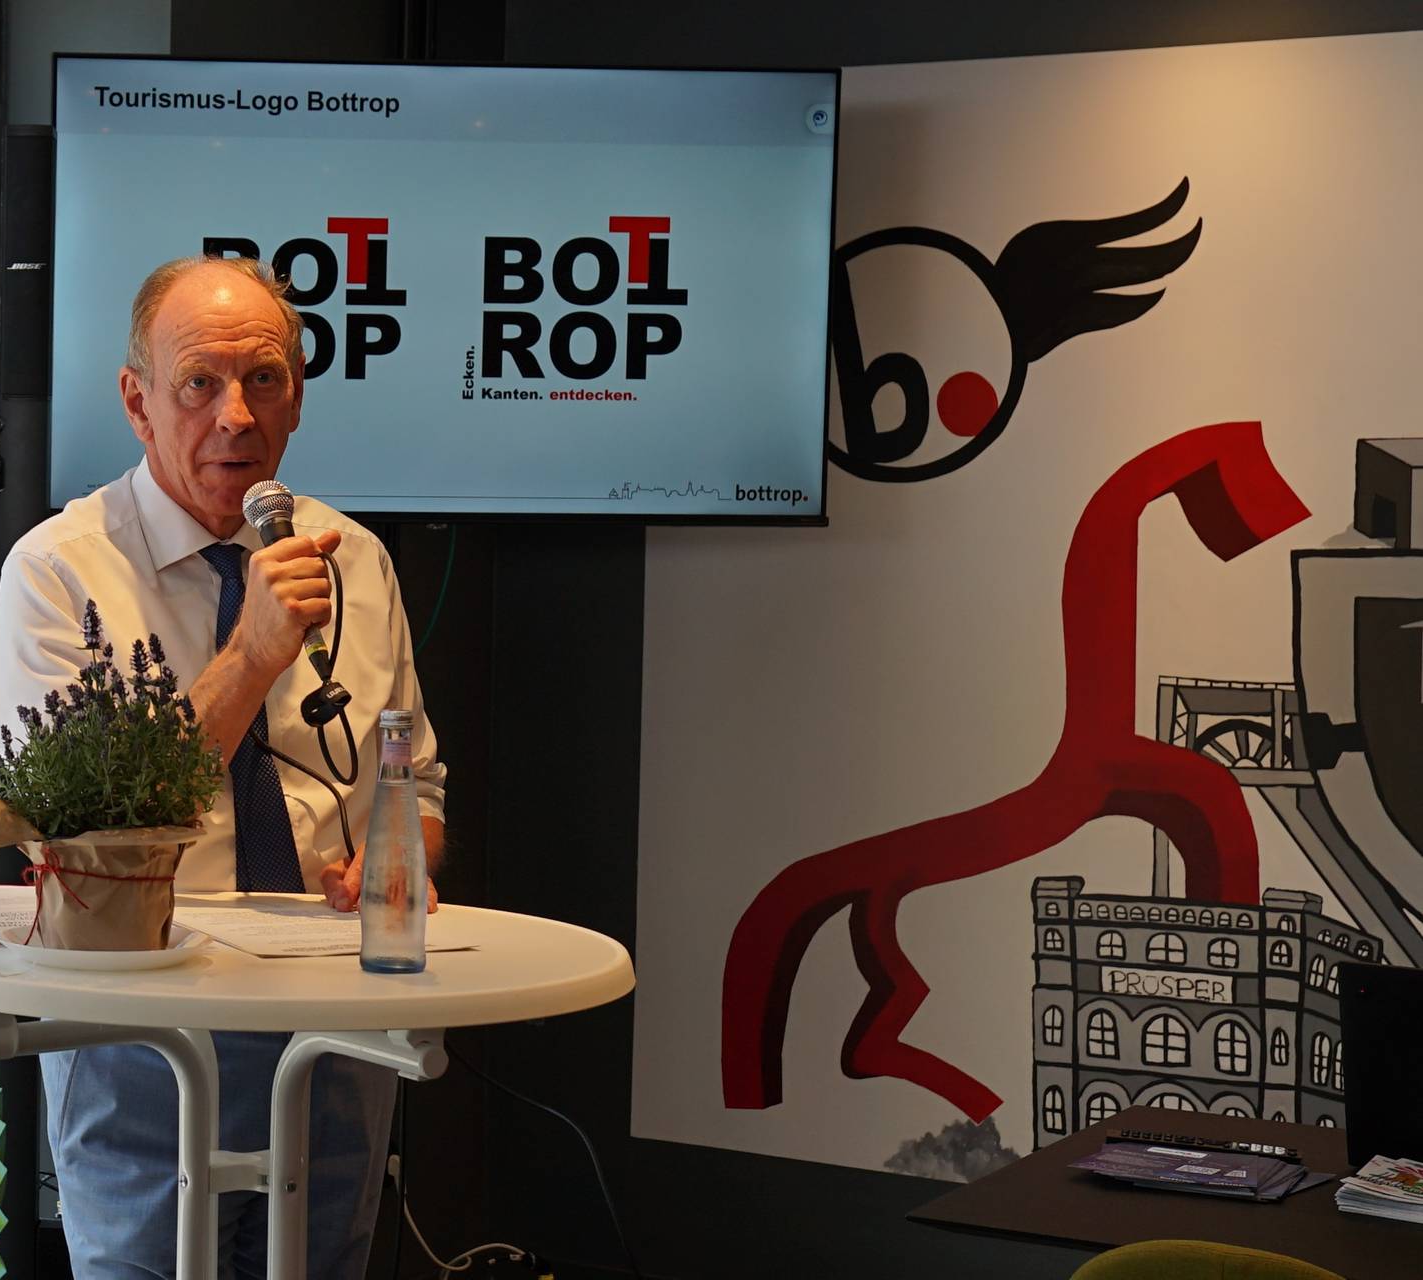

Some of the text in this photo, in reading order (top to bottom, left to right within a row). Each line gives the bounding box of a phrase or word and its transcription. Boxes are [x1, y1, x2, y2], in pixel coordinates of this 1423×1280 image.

[94, 86, 400, 118] Tourismus-Logo Bottrop
[482, 311, 683, 380] ROP
[463, 345, 475, 400] Ecken.
[481, 387, 637, 401] Kanten. entdecken.
[735, 483, 809, 506] bottrop.
[1108, 970, 1226, 1001] PROSPER
